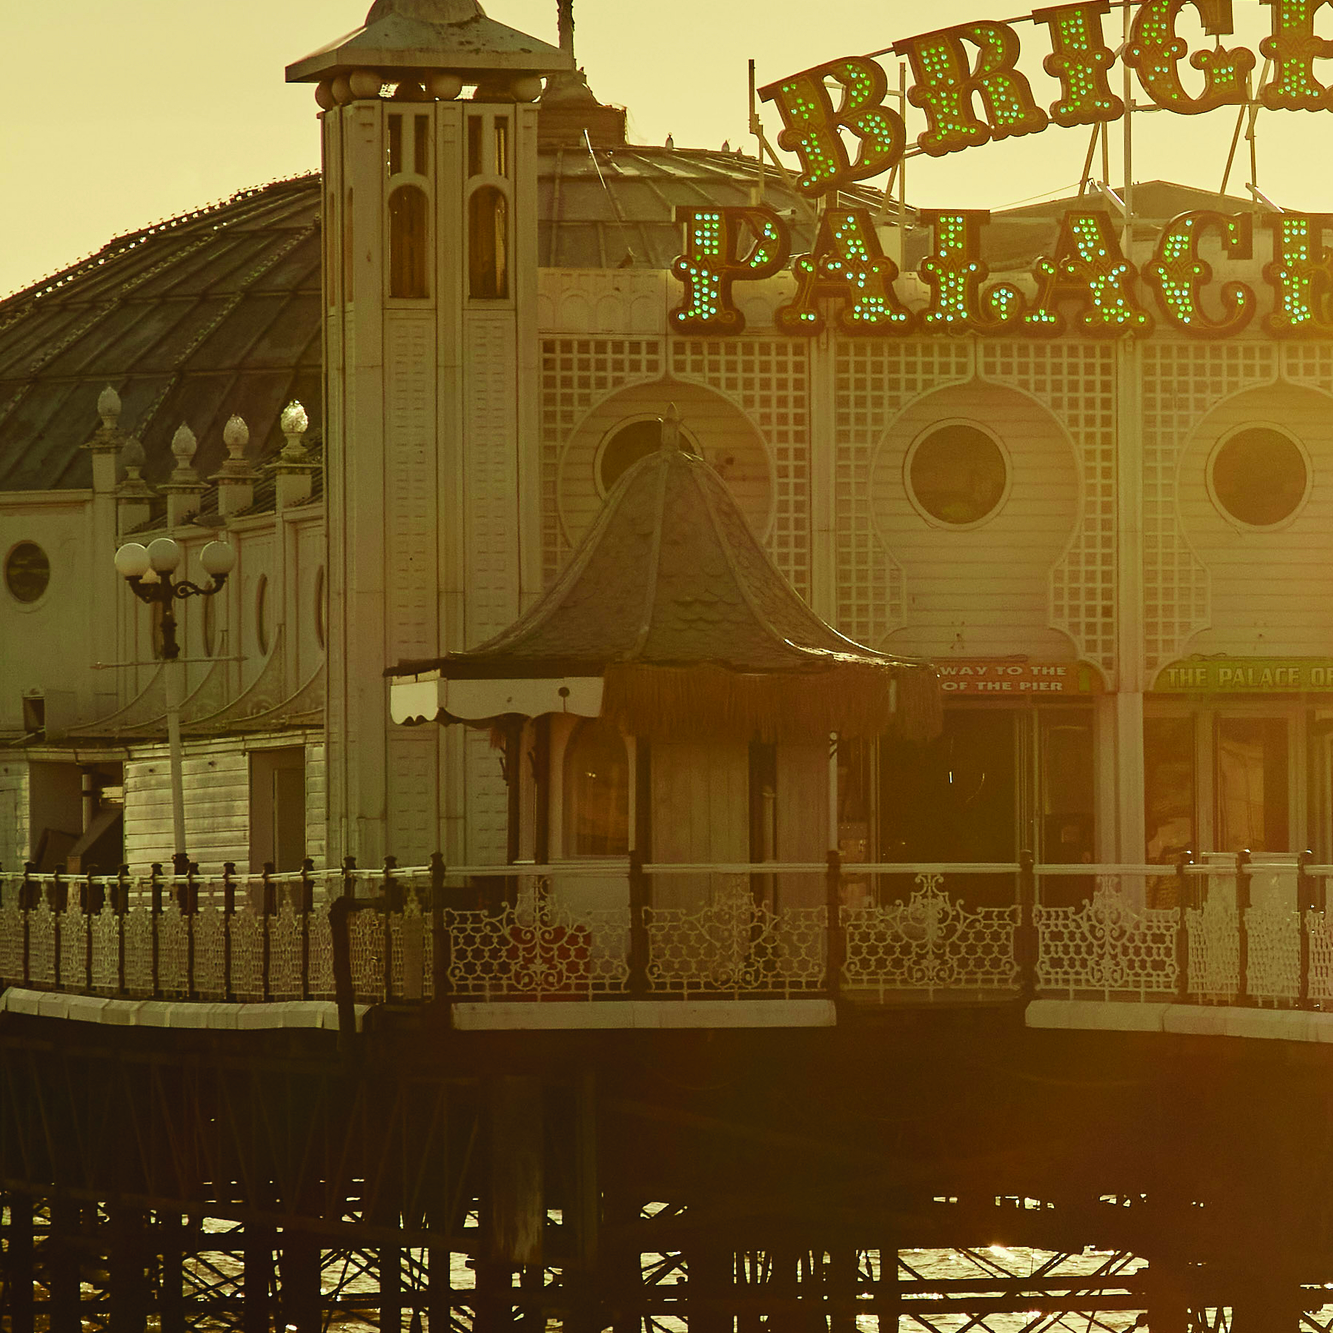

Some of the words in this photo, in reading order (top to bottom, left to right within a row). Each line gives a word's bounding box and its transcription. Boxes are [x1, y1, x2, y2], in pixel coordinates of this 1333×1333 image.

[940, 666, 988, 675] WAY
[995, 666, 1023, 675] TO
[1030, 666, 1067, 676] THE
[1167, 667, 1207, 686] THE
[1218, 667, 1299, 687] PALACE
[941, 681, 968, 691] OF
[976, 681, 1012, 691] THE
[1019, 681, 1063, 691] PIER
